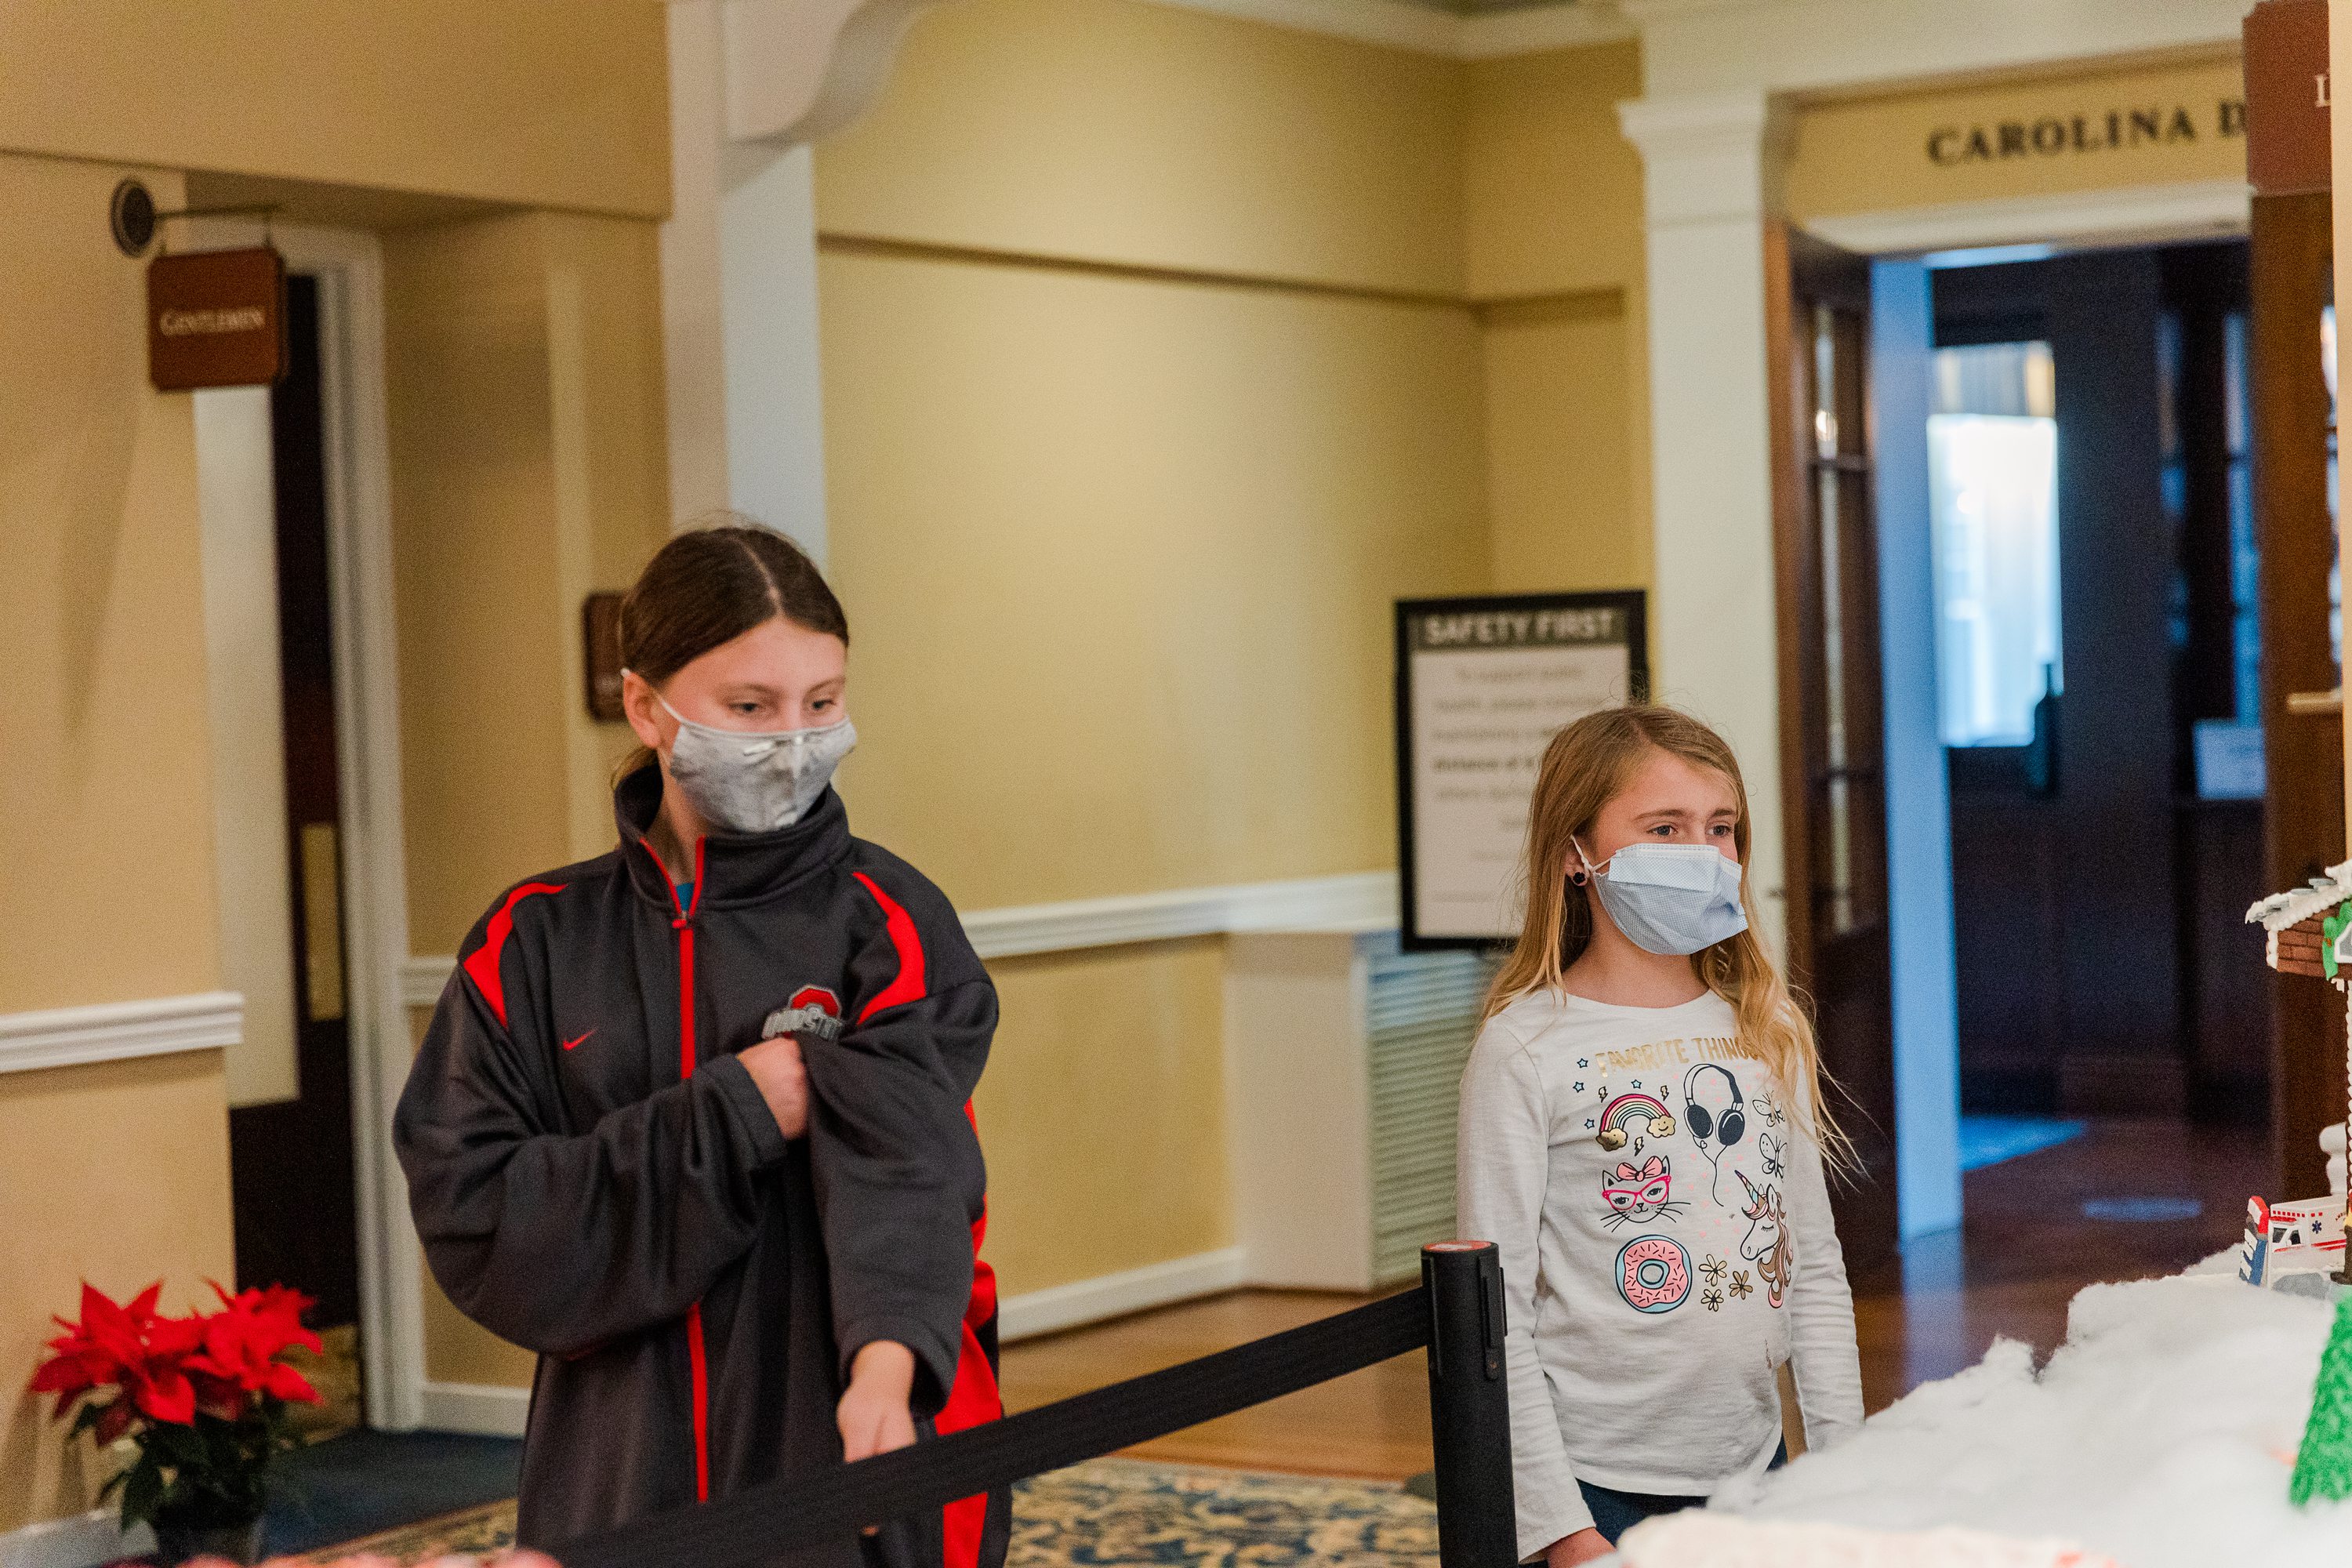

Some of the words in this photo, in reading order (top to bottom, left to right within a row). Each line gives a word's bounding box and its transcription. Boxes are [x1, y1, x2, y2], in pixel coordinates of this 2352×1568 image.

[1926, 107, 2197, 167] CAROLINA
[1425, 612, 1529, 644] SAFETY
[1535, 608, 1613, 641] FIRST
[1595, 1038, 1690, 1078] FAVORITE
